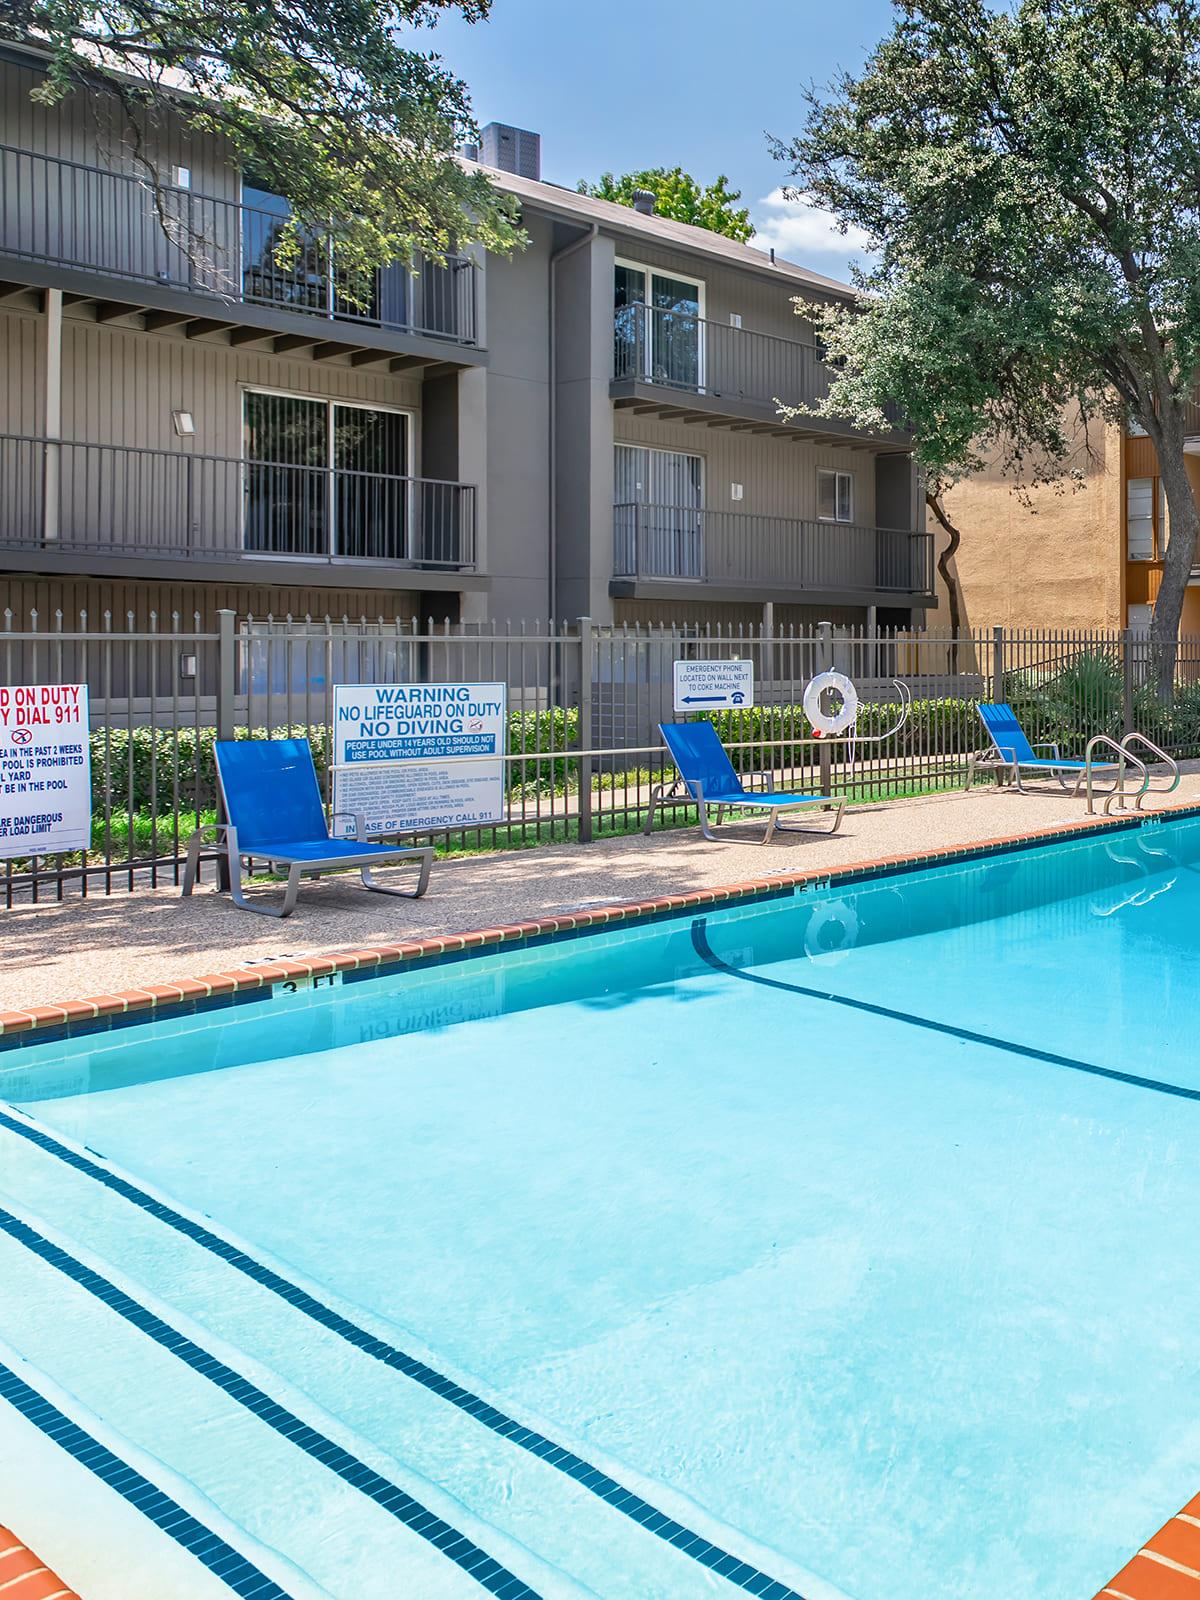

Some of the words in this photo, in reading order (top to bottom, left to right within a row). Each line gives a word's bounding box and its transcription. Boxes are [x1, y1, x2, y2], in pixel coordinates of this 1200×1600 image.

[15, 688, 35, 706] ON
[42, 686, 79, 705] DUTY
[376, 688, 470, 703] WARNING
[16, 707, 50, 725] DIAL
[55, 705, 79, 723] 911
[339, 706, 360, 721] NO
[365, 704, 442, 720] LIFEGUARD
[446, 703, 464, 717] ON
[468, 703, 501, 716] DUTY
[360, 721, 390, 737] NO
[397, 719, 463, 736] DIVING
[346, 742, 376, 750] PEOPLE
[378, 740, 402, 749] UNDER
[412, 738, 435, 747] YEARS
[452, 736, 480, 745] SHOULD
[10, 748, 17, 757] IN
[19, 748, 33, 756] THE
[35, 746, 51, 756] PAST
[54, 746, 57, 754] 2
[59, 745, 82, 754] WEEKS
[352, 751, 366, 759] USE
[369, 750, 389, 758] POOL
[390, 748, 422, 757] WITHOUT
[424, 747, 444, 755] ADULT
[446, 744, 489, 754] SUPERVISION
[3, 760, 24, 769] POOL
[27, 760, 34, 768] IS
[37, 756, 83, 767] PROHIBITED
[8, 772, 31, 781] YARD
[5, 784, 15, 793] BE
[18, 783, 26, 792] IN
[29, 782, 44, 791] THE
[47, 780, 67, 790] POOL
[14, 813, 62, 826] DANGEROUS
[365, 822, 383, 831] ASE
[385, 821, 397, 829] OF
[400, 816, 454, 827] EMERGENCY
[456, 813, 477, 822] CALL
[10, 826, 30, 836] LOAD
[32, 824, 52, 833] LIMIT
[282, 982, 298, 994] 3
[313, 973, 338, 989] FT
